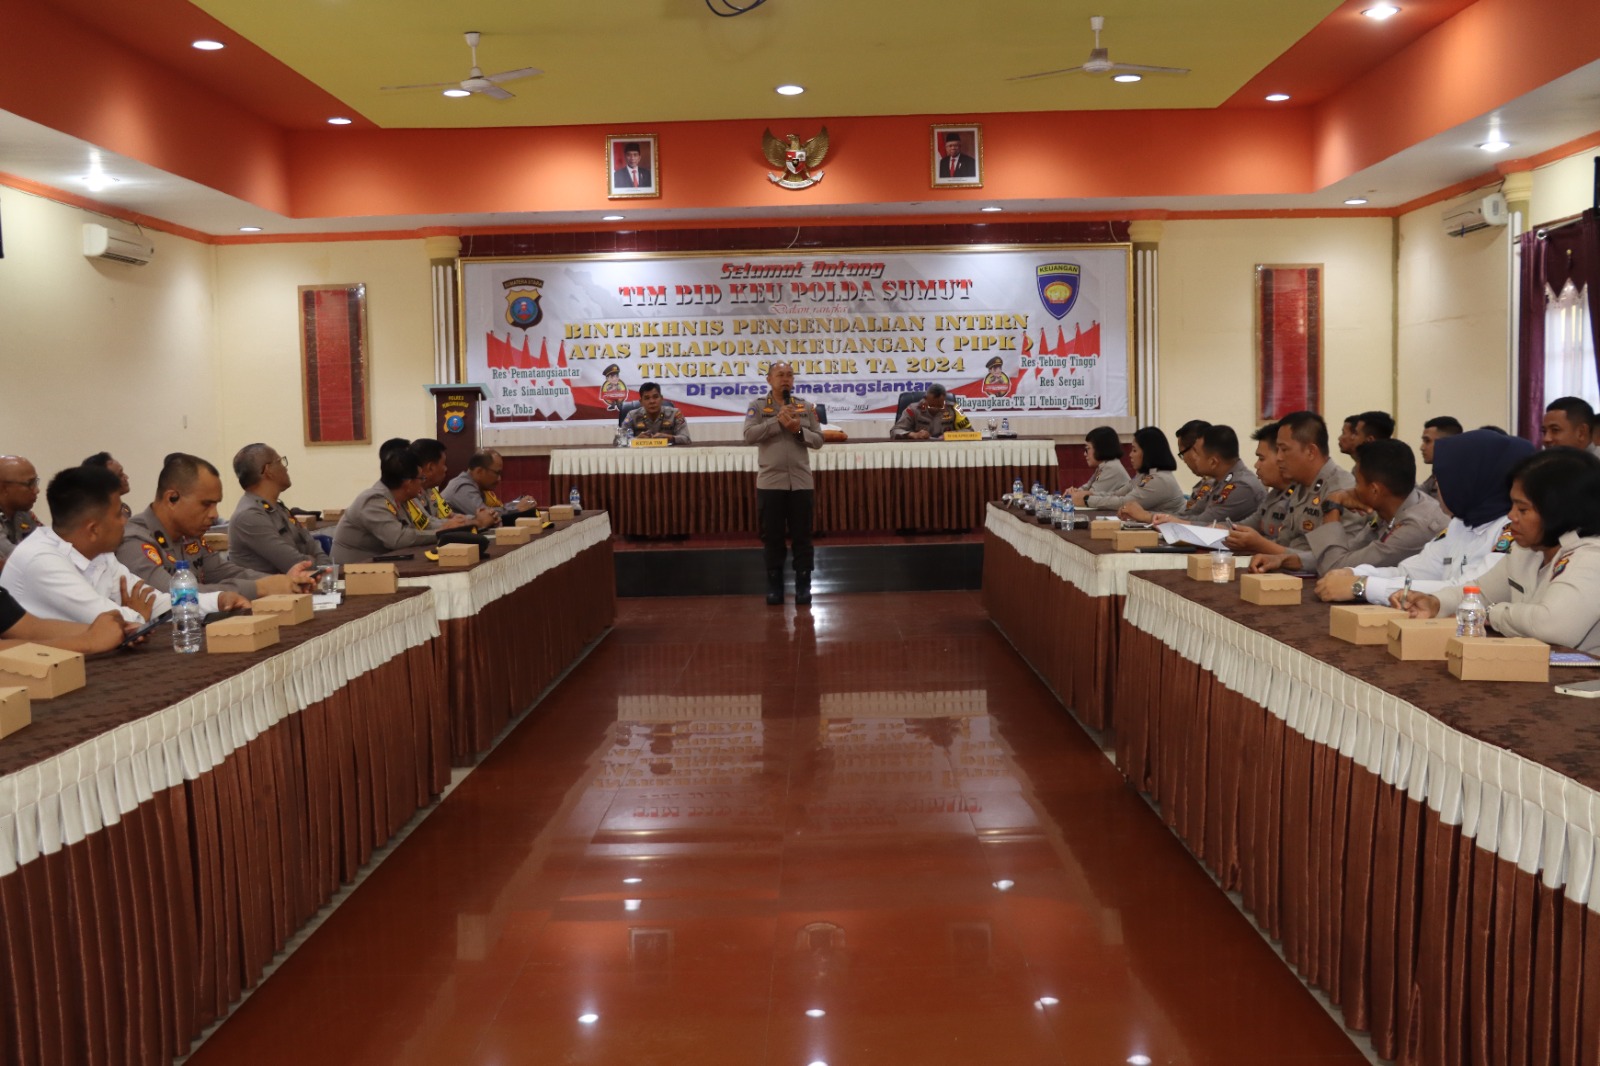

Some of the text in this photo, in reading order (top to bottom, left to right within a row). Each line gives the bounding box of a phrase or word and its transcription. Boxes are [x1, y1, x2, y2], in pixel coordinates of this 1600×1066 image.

[720, 261, 885, 280] Selamat Datang
[1039, 265, 1078, 273] KEUANGAN
[618, 279, 973, 307] TIM BID KEU POLDA SUMUT
[564, 314, 1029, 339] BINTEKHNIS PENGENDALIAN INTERN
[569, 342, 632, 360] ATAS
[639, 335, 927, 358] PELAPORANKEUANGAN
[953, 335, 1017, 352] PIPK
[637, 356, 967, 379] TINGKAT STKER TA 2024
[1021, 356, 1097, 368] Res Tebing Tinggi
[492, 368, 580, 380] Res Pematangsiantar
[1040, 376, 1085, 388] Res Sergai
[502, 386, 570, 397] Res Simalungun
[686, 380, 933, 399] Di polres ematangsiantar
[957, 397, 1011, 409] Bhayangkara
[1014, 397, 1026, 406] TK
[1040, 396, 1070, 408] Tebing
[1070, 395, 1097, 407] Tinggi
[496, 404, 534, 415] Res Toba
